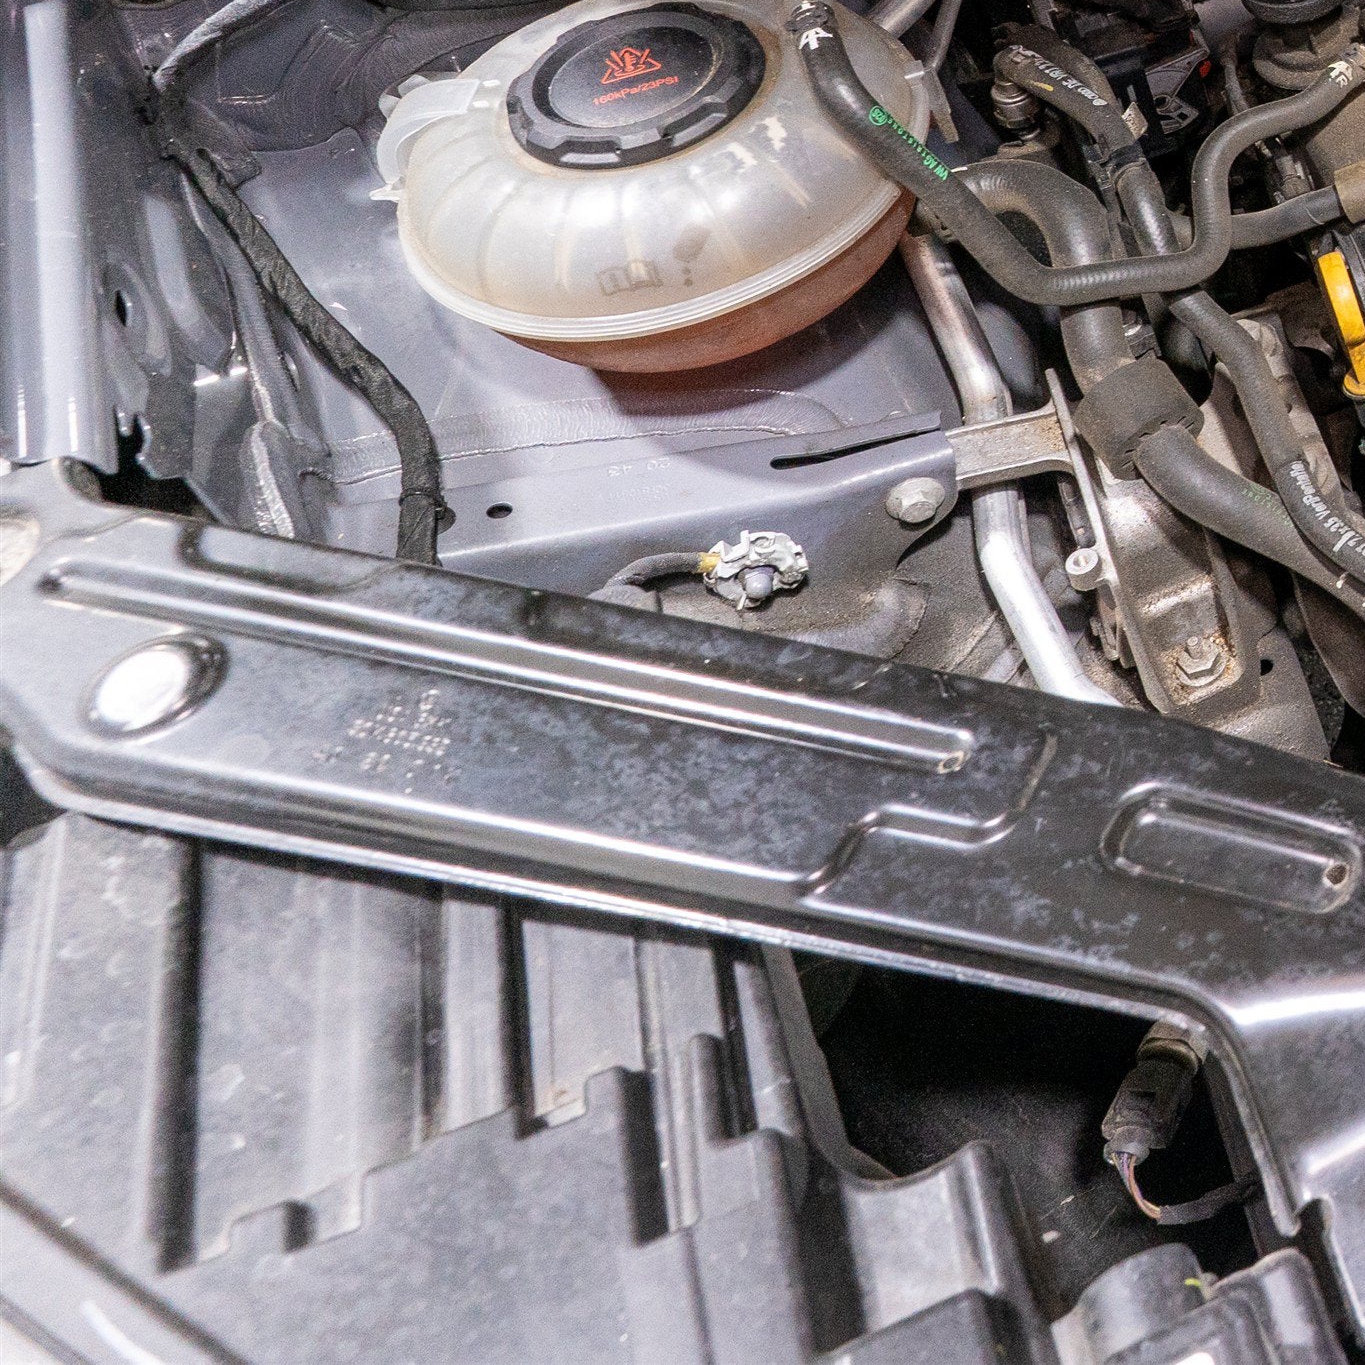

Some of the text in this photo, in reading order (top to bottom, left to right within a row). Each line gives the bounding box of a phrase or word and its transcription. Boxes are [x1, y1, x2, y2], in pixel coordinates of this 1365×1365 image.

[592, 76, 679, 105] 160kPa/23PSI
[921, 153, 950, 181] VW AG
